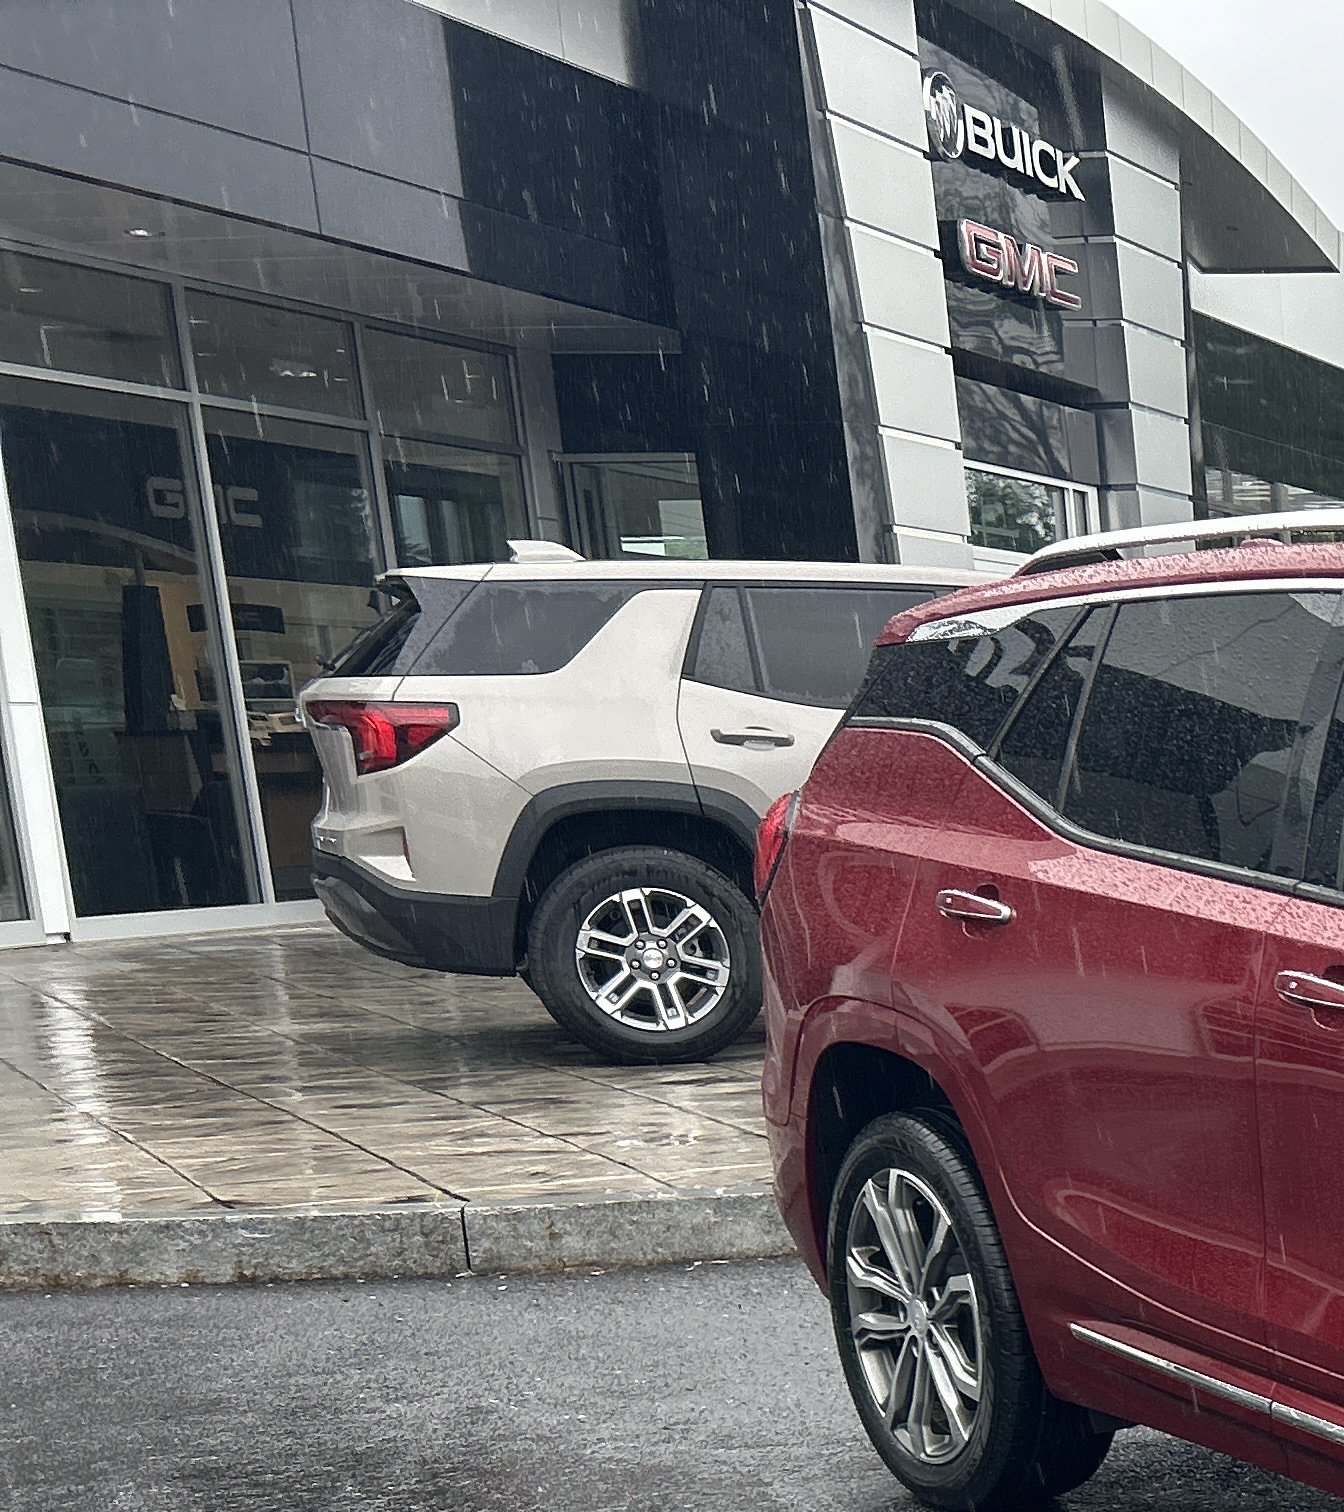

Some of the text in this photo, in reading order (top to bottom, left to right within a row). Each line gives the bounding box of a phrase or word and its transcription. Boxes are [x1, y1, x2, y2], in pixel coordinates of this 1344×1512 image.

[963, 103, 1086, 202] BUICK
[957, 217, 1082, 311] GMC
[147, 476, 264, 528] GC
